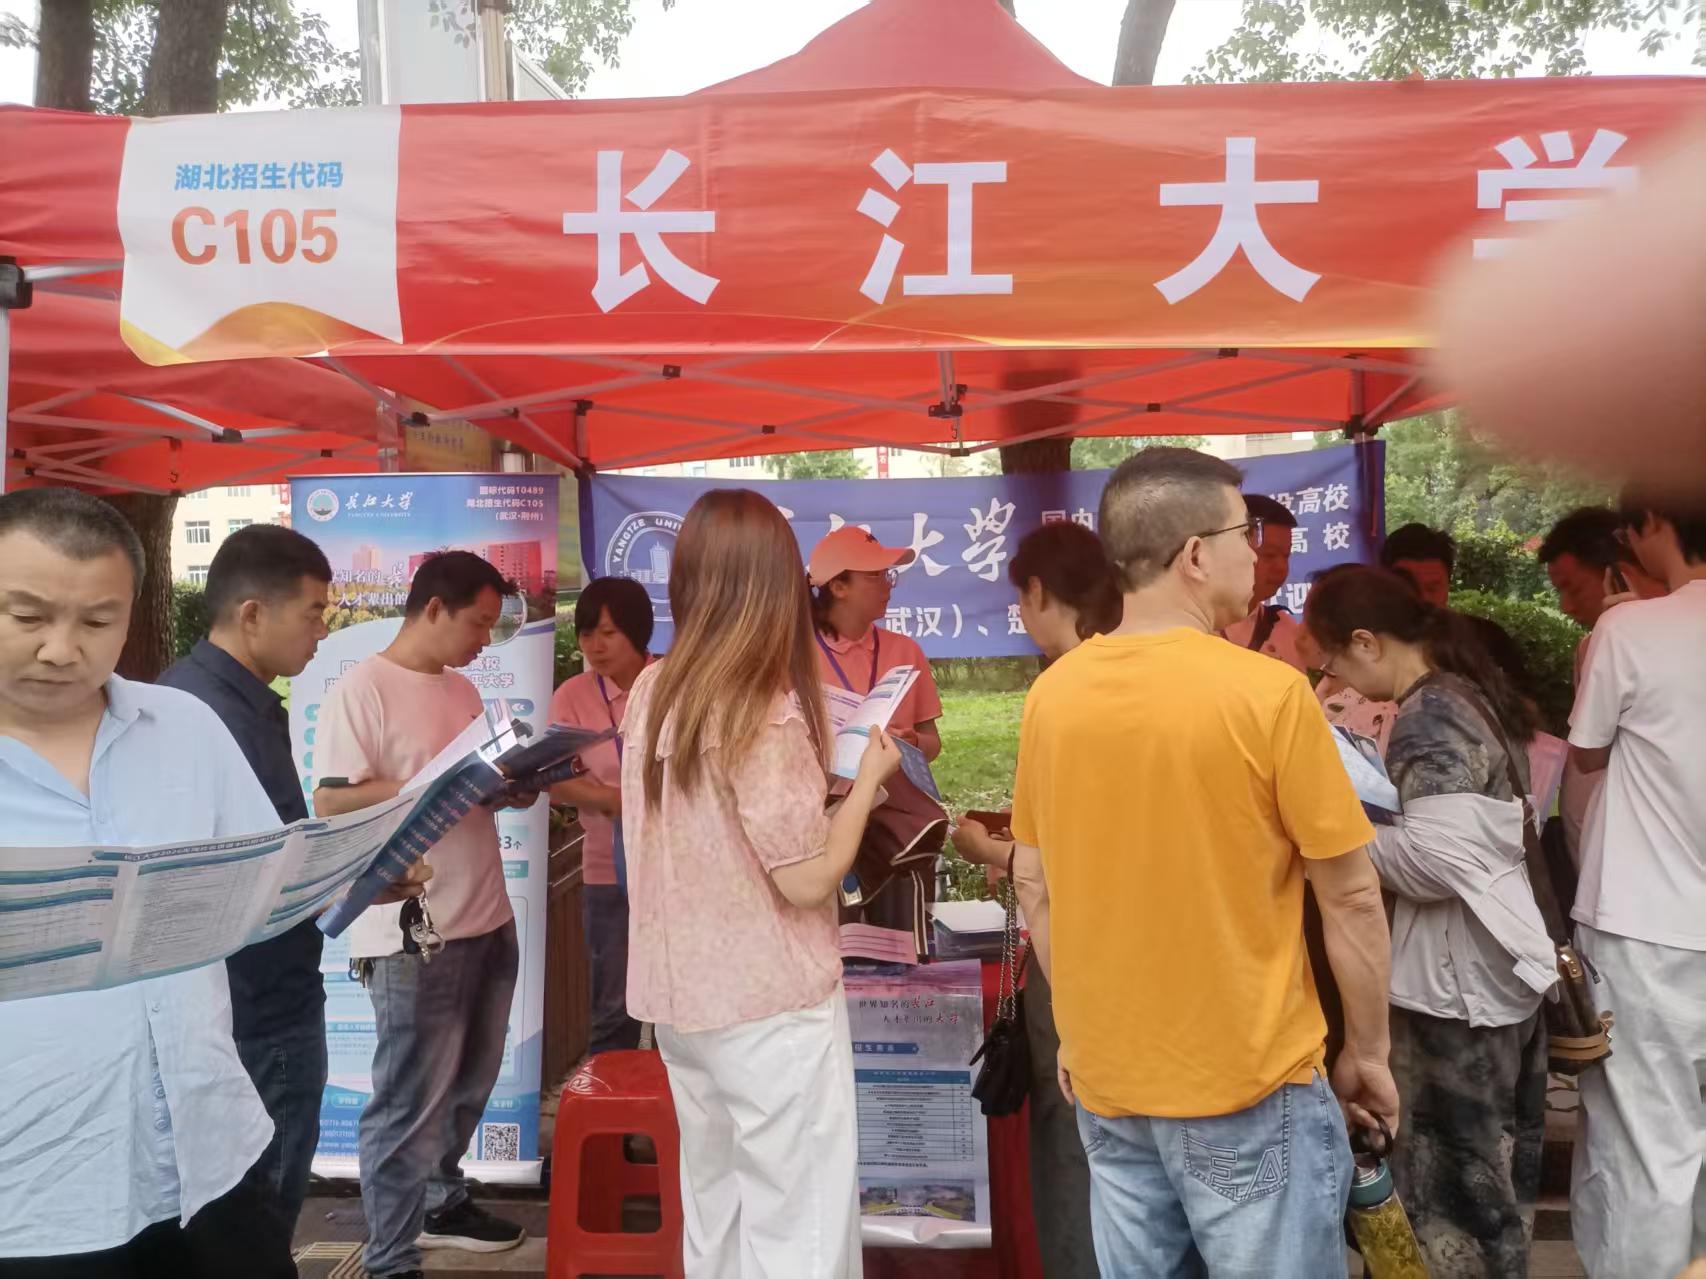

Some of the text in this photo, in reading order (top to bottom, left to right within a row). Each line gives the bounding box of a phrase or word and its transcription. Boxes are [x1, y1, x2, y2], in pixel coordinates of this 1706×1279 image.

[174, 161, 344, 191] 湖北招生代码
[171, 205, 339, 265] C105
[466, 498, 544, 508] 湖北招生代码C105
[612, 518, 646, 563] YANGTZE
